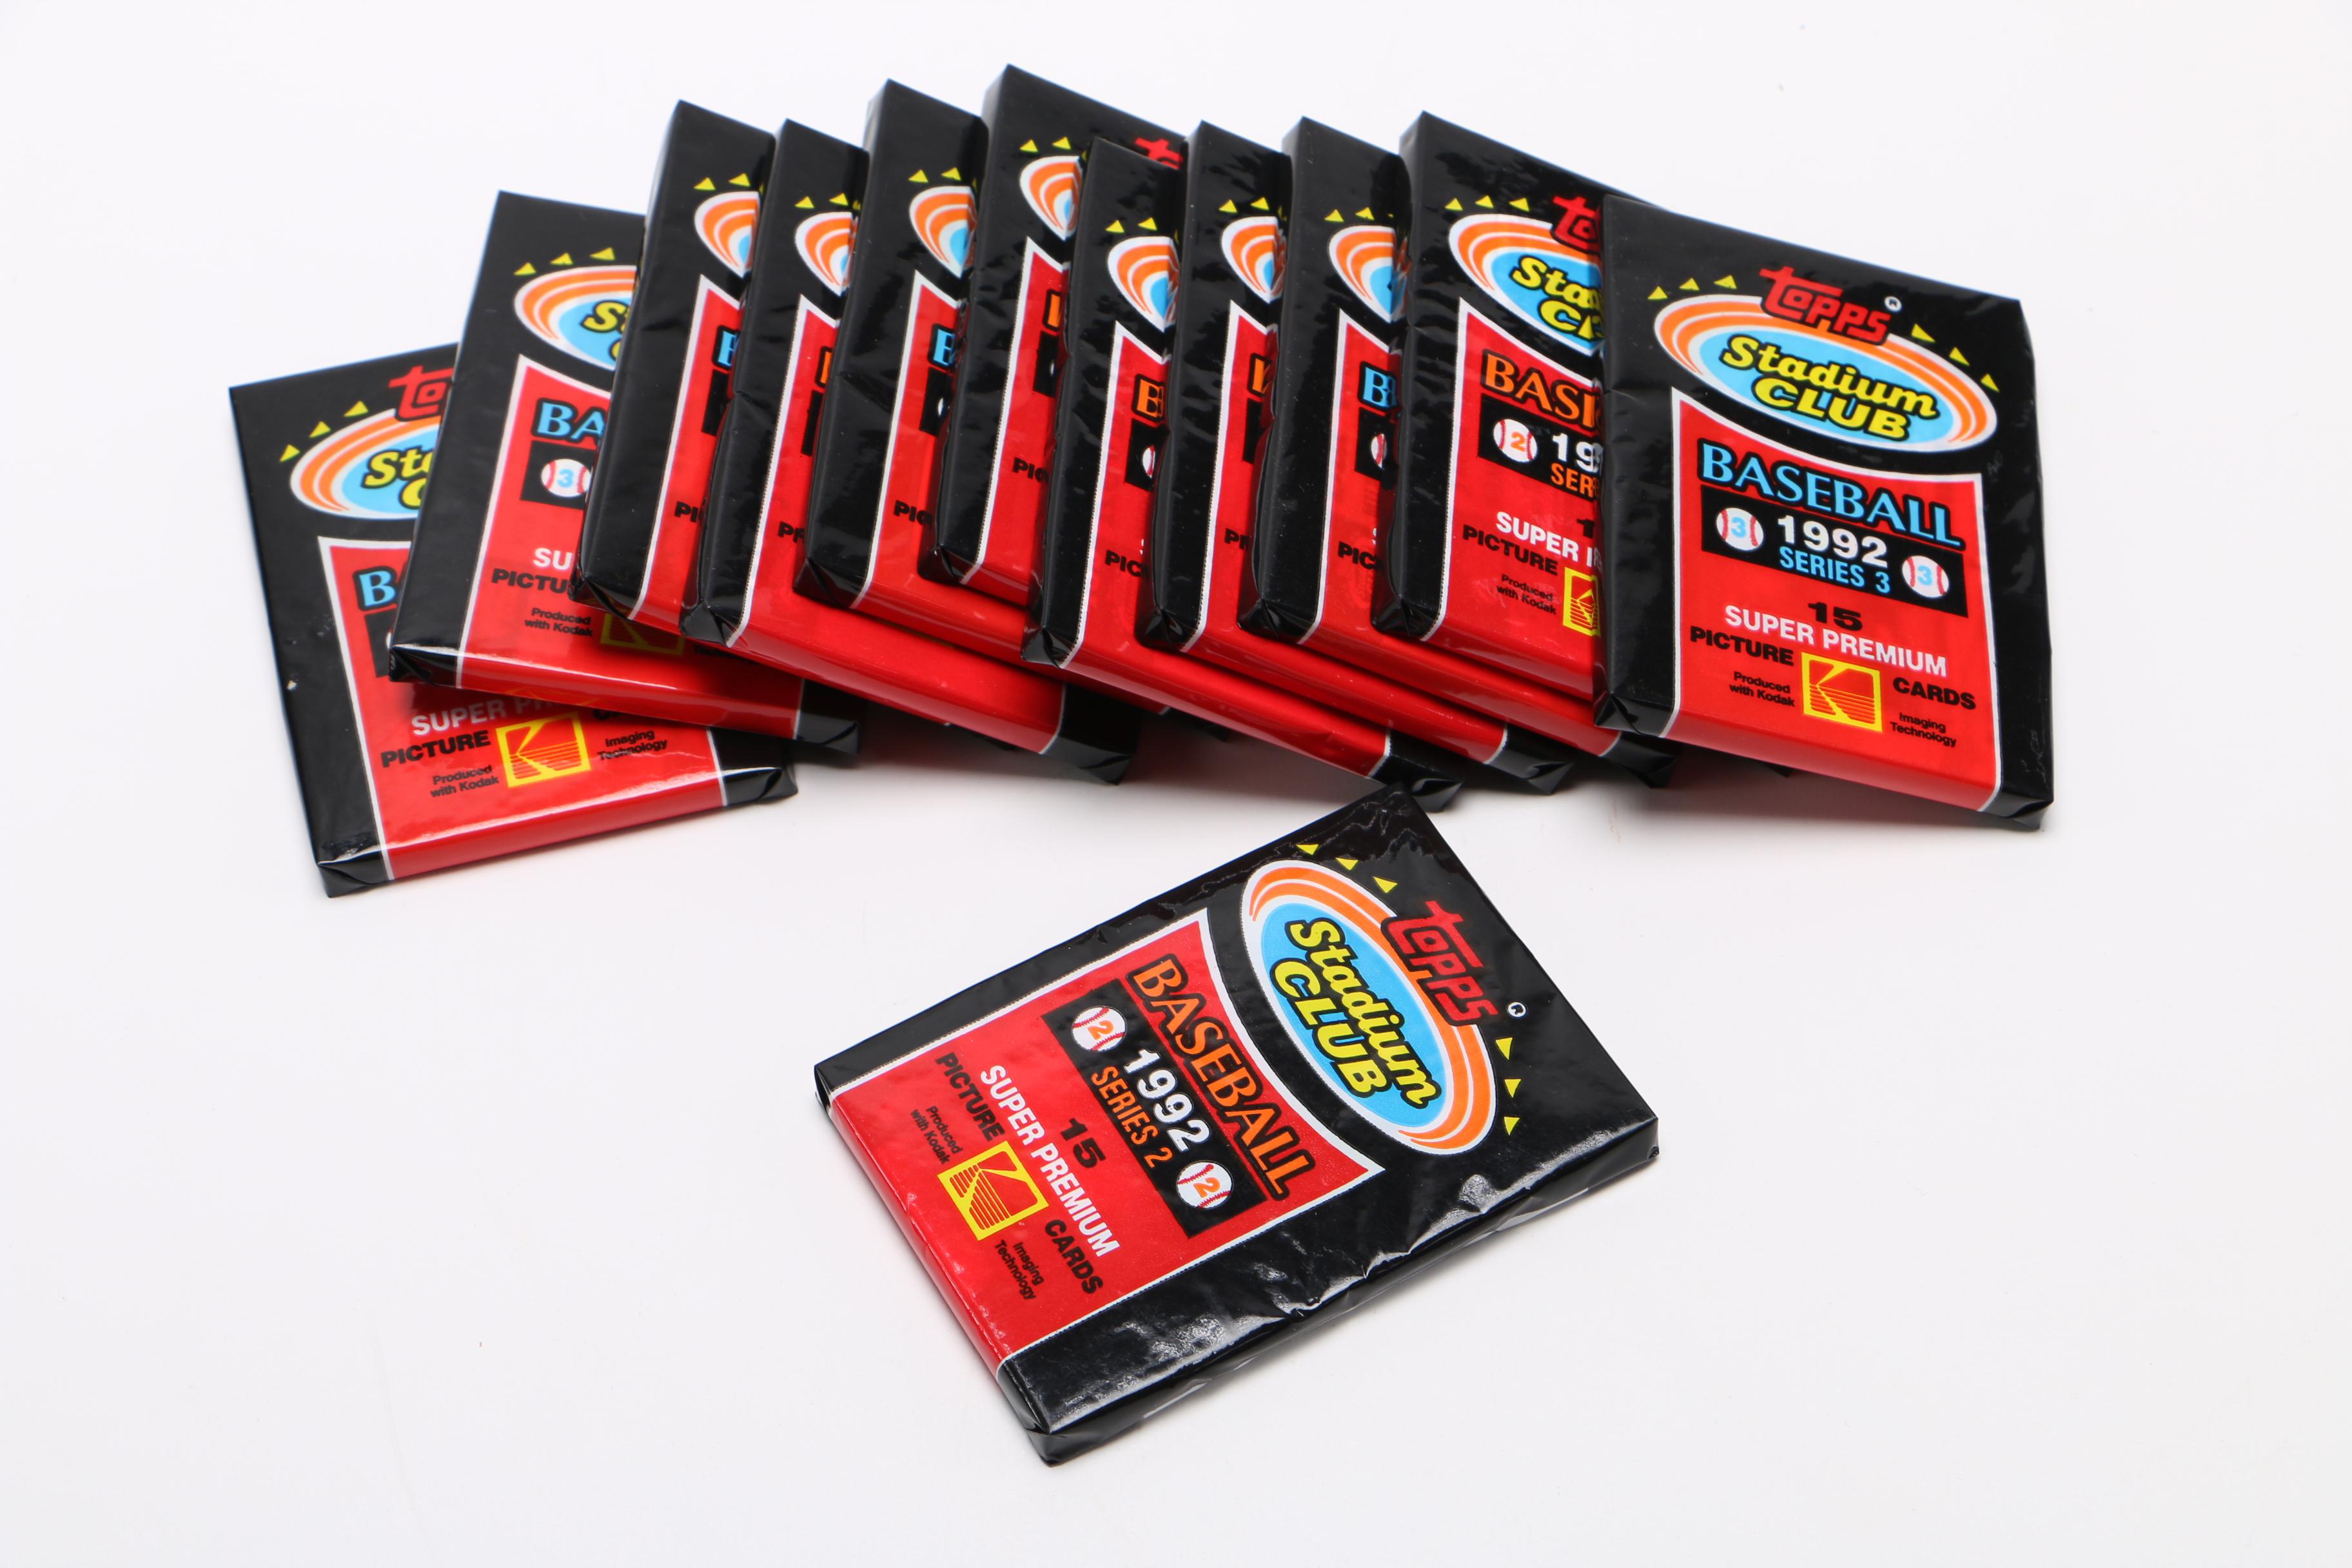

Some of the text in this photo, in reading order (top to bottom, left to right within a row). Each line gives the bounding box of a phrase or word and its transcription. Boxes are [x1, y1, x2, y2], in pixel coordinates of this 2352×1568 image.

[1720, 333, 1939, 418] Stadium
[1751, 375, 1911, 442] CLUB
[1510, 431, 1527, 453] 2
[556, 468, 575, 488] 3
[1698, 438, 1966, 551] BASEBALL
[1496, 511, 1579, 562] SUPER
[1731, 516, 1747, 538] 3
[1777, 514, 1888, 569] 1992
[1462, 524, 1558, 576] PICTURE
[1779, 546, 1890, 594] SERIES 3
[1501, 573, 1554, 602] Produced
[1917, 564, 1933, 586] 3
[530, 607, 592, 625] Produced
[1496, 585, 1556, 615] with Kodak
[1808, 602, 1863, 631] 15
[524, 618, 593, 637] with Kodak
[1690, 625, 1794, 667] PICTURE
[1723, 604, 1948, 677] SUPER PREMIUM
[1729, 683, 1795, 708] with Kodak
[1733, 671, 1790, 694] Produced
[1892, 676, 1977, 710] CARDS
[411, 699, 506, 736] SUPER
[1890, 721, 1956, 749] Technology
[1899, 712, 1946, 734] Imaging
[380, 730, 491, 768] PICTURE
[597, 740, 668, 761] Technology
[605, 730, 656, 748] Imaging
[430, 775, 499, 798] with Kodak
[433, 765, 493, 785] Produced
[1091, 1020, 1115, 1041] 2
[1269, 958, 1393, 1097] CLUB
[1285, 918, 1443, 1109] Stadium
[1126, 953, 1315, 1200] BASEBALL
[935, 1052, 1006, 1142] PICTURE
[1091, 1065, 1175, 1169] SERIES 2
[1123, 1047, 1212, 1153] 1992
[910, 1109, 951, 1165] with Kodak
[925, 1105, 964, 1155] Produced
[1060, 1117, 1107, 1168] 15
[980, 1064, 1122, 1257] SUPER PREMIUM
[1193, 1177, 1221, 1199] 2
[994, 1239, 1037, 1300] Technology
[1013, 1241, 1045, 1286] Imaging
[1044, 1219, 1104, 1295] CARDS
